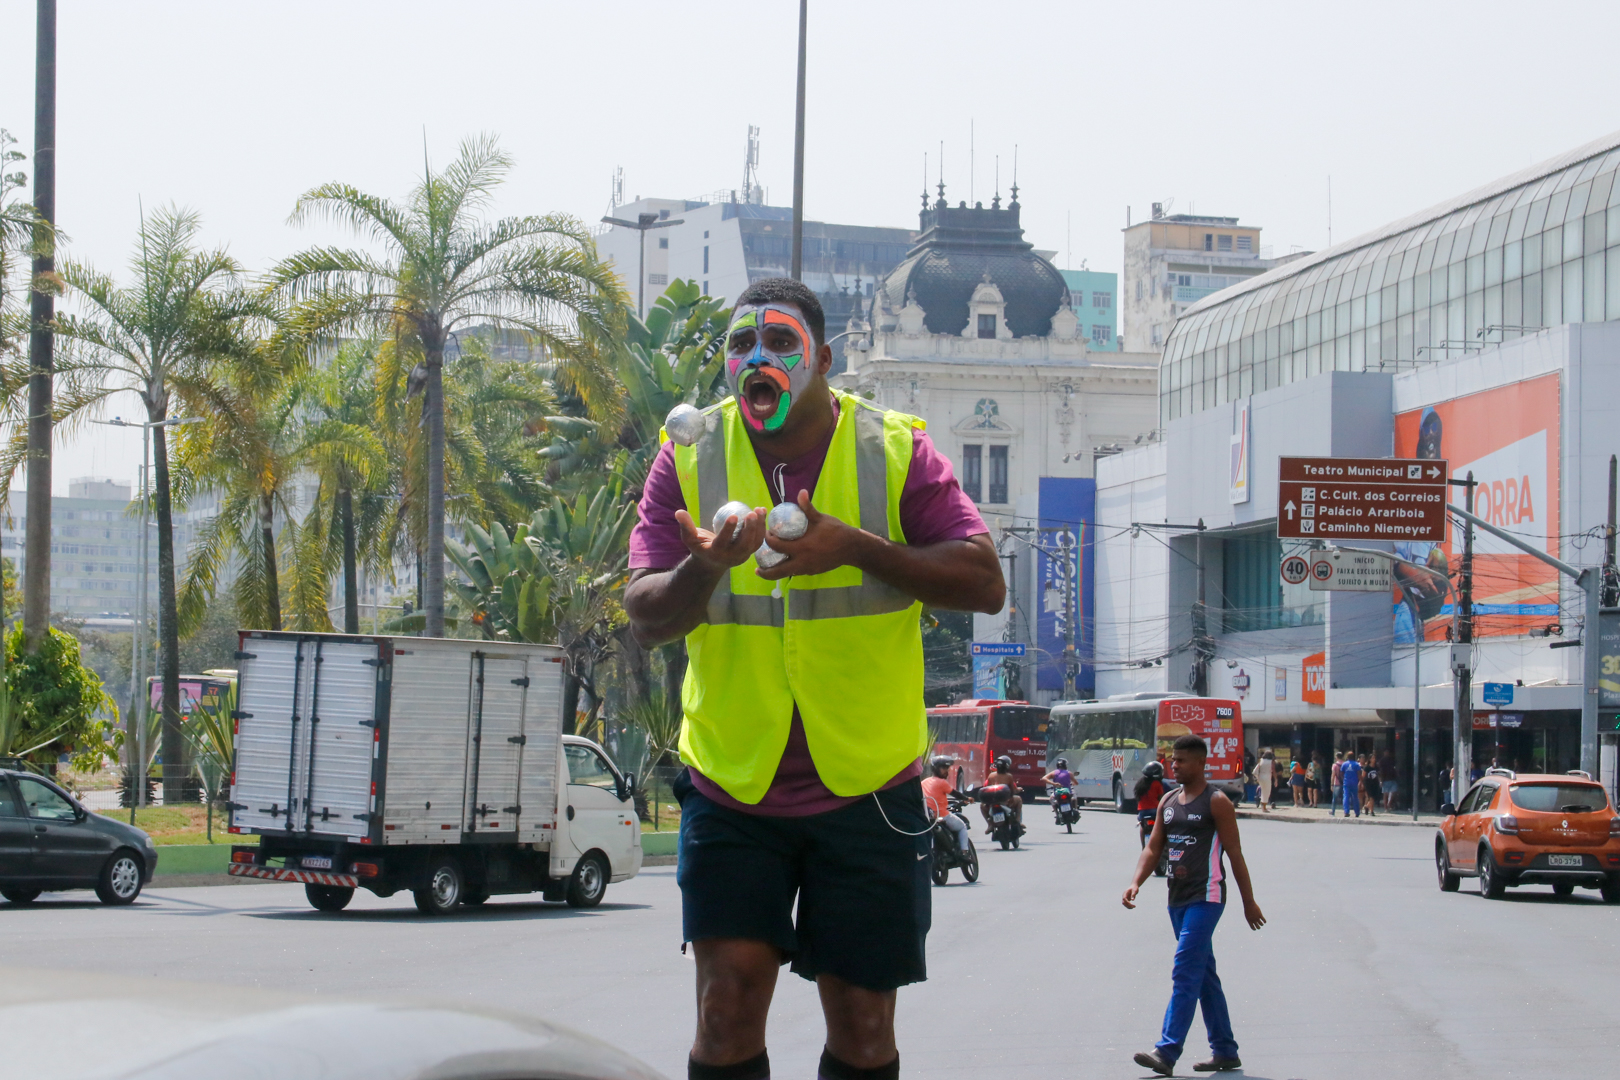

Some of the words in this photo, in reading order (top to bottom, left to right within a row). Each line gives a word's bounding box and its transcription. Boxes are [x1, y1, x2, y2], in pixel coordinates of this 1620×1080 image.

[1303, 465, 1344, 475] Teatro
[1347, 466, 1404, 478] Municipal
[1332, 490, 1361, 501] Cult.
[1364, 491, 1386, 501] dos
[1389, 492, 1441, 502] Correios
[1463, 475, 1534, 531] ORRA
[1319, 505, 1363, 516] Palácio
[1368, 507, 1425, 518] Arariboia
[1319, 522, 1370, 533] Caminho
[1374, 523, 1432, 536] Niemeyer
[1354, 556, 1375, 564] INÍCIO
[1286, 562, 1304, 575] 40
[1171, 704, 1205, 723] Bob's
